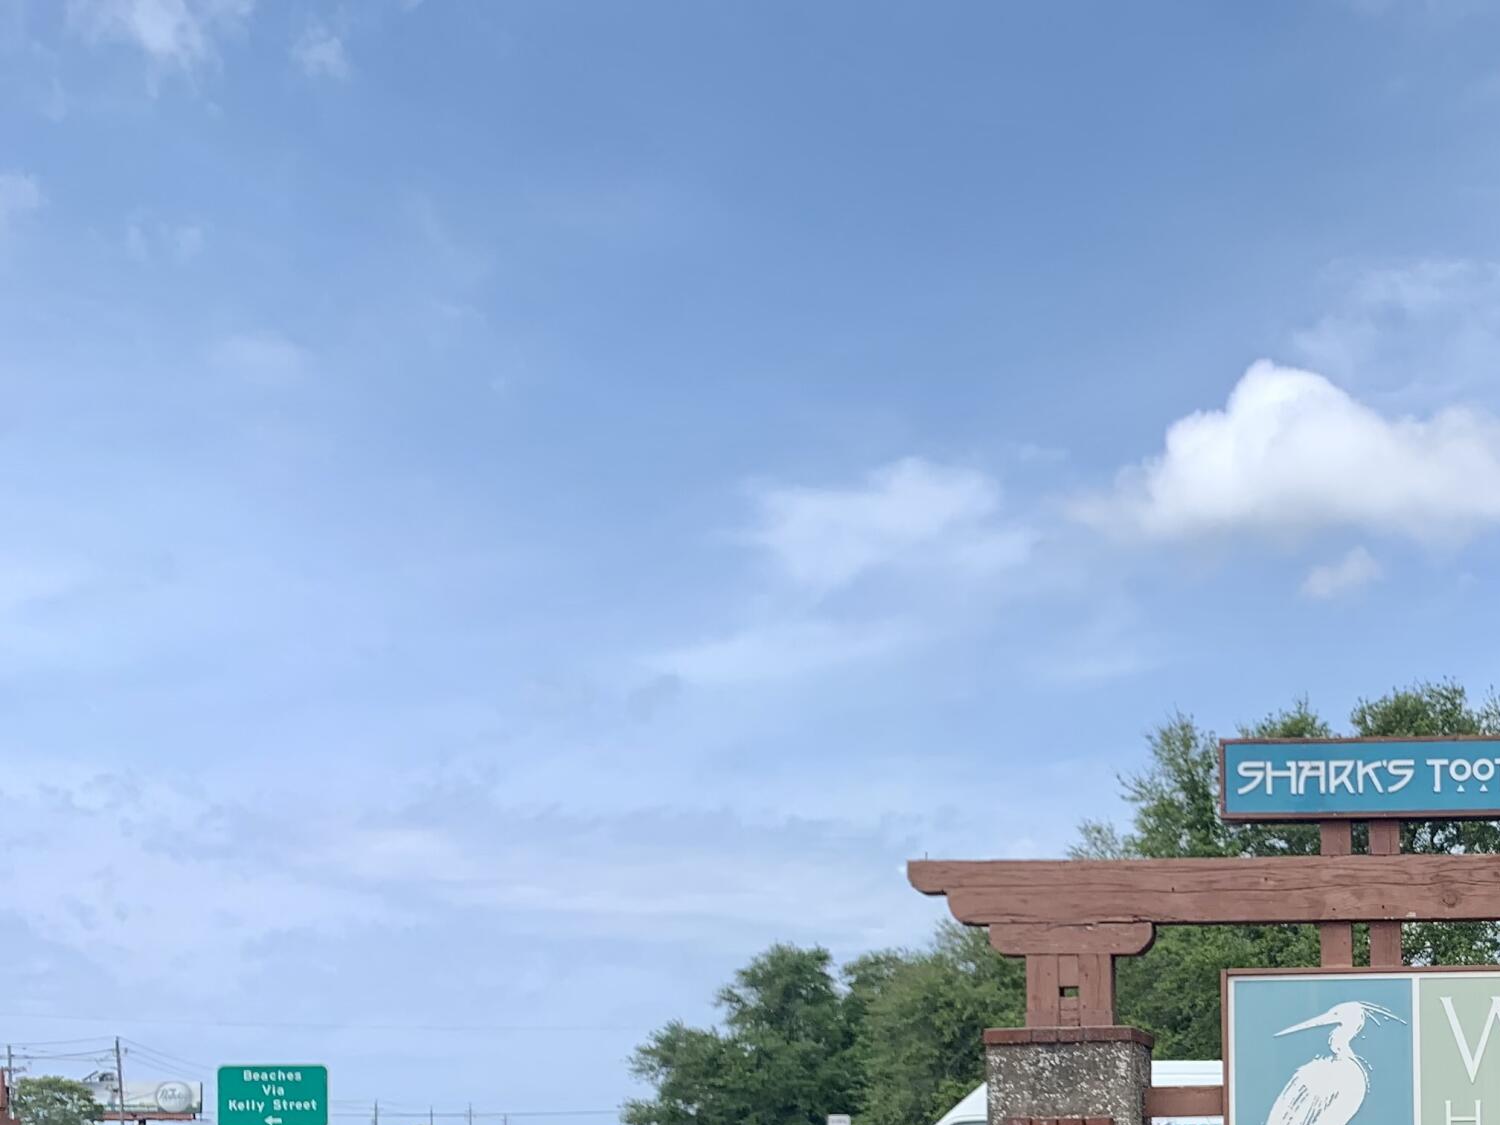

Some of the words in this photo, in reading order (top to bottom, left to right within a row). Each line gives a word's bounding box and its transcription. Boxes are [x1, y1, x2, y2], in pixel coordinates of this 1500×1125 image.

[1237, 759, 1415, 795] SHARK'S
[243, 1069, 302, 1081] Beaches
[262, 1084, 285, 1096] Via
[228, 1099, 265, 1113] Kelly
[272, 1099, 318, 1111] Street
